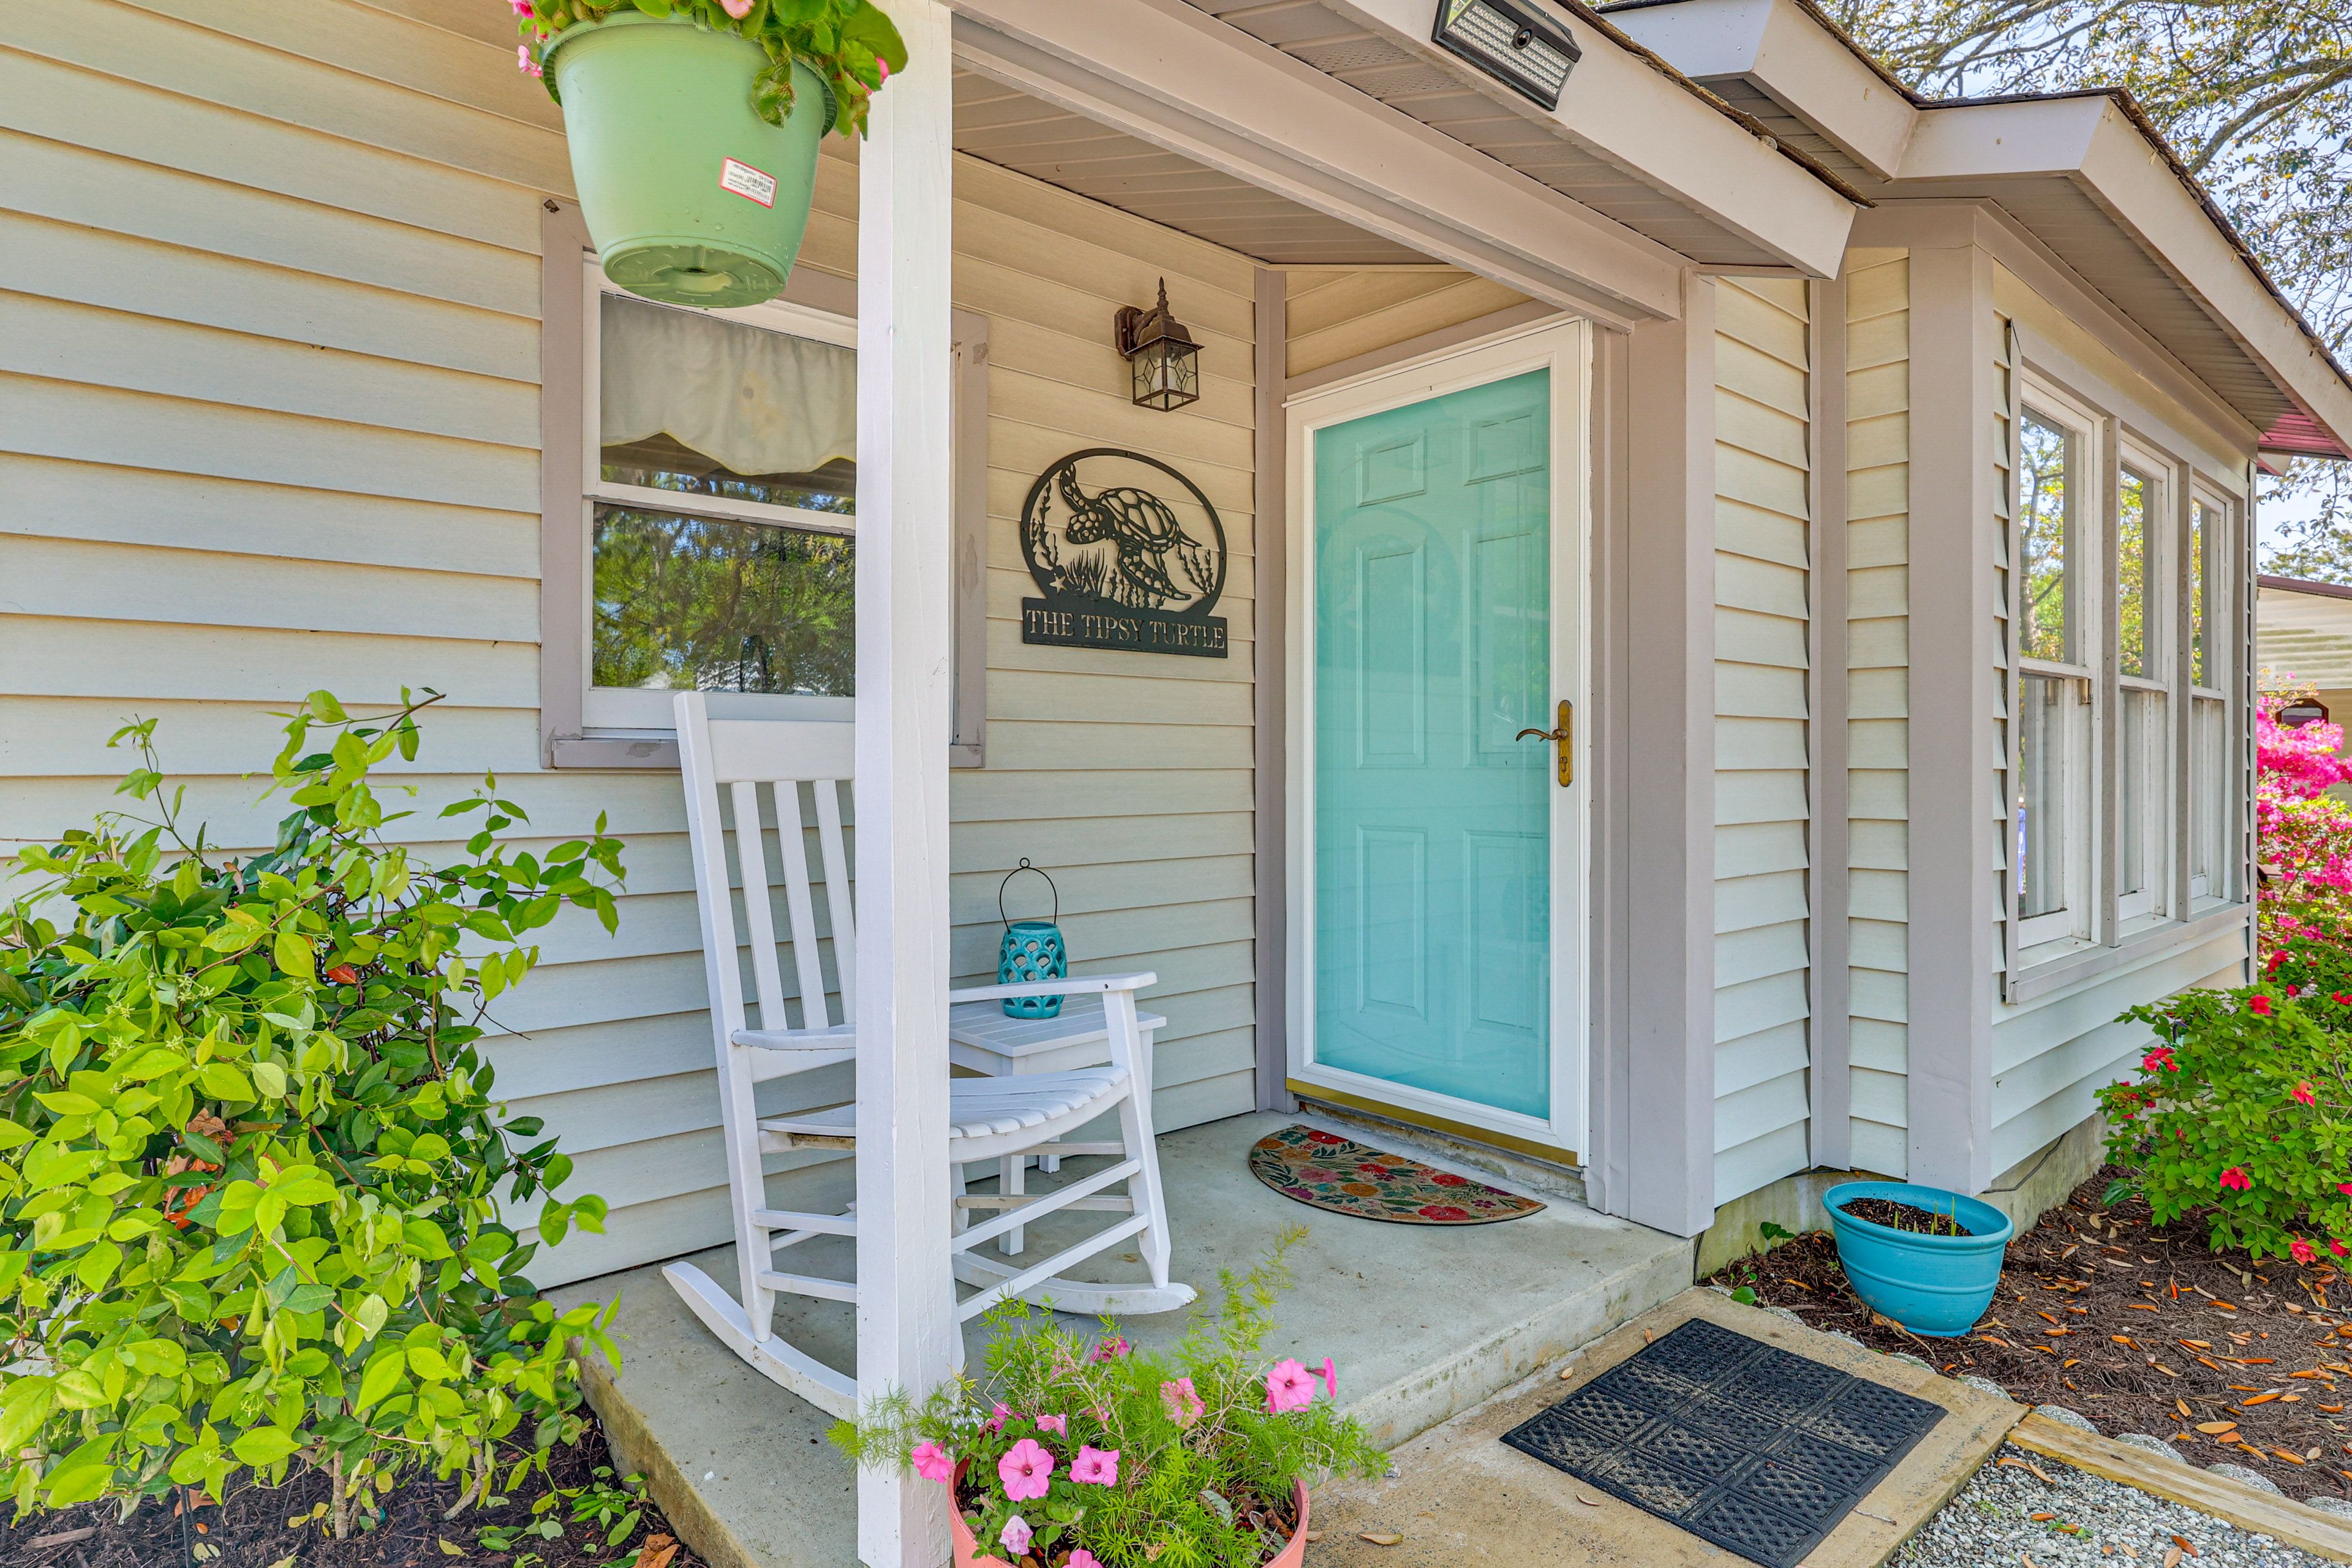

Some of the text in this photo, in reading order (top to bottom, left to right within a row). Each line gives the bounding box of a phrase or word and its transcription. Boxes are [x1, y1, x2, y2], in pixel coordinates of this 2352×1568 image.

[1026, 609, 1225, 649] THE TIPSY TURTLE
